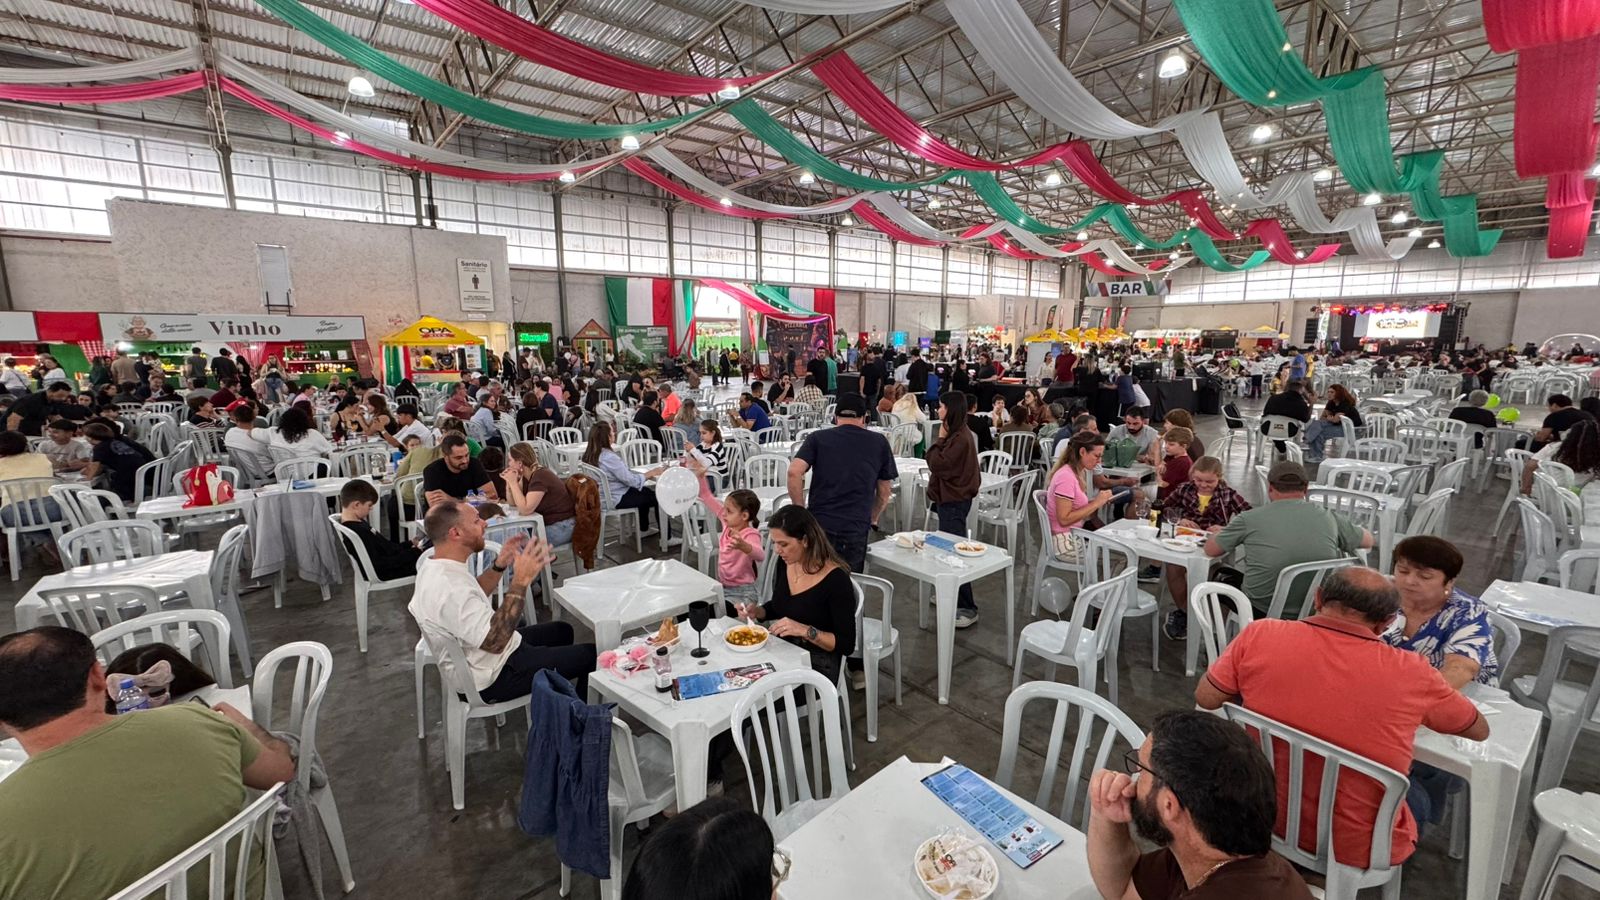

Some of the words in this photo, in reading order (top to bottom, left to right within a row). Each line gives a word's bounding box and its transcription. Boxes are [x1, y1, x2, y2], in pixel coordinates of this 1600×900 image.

[460, 260, 488, 268] Sanitário
[1110, 283, 1142, 295] BAR
[208, 320, 282, 336] Vinho
